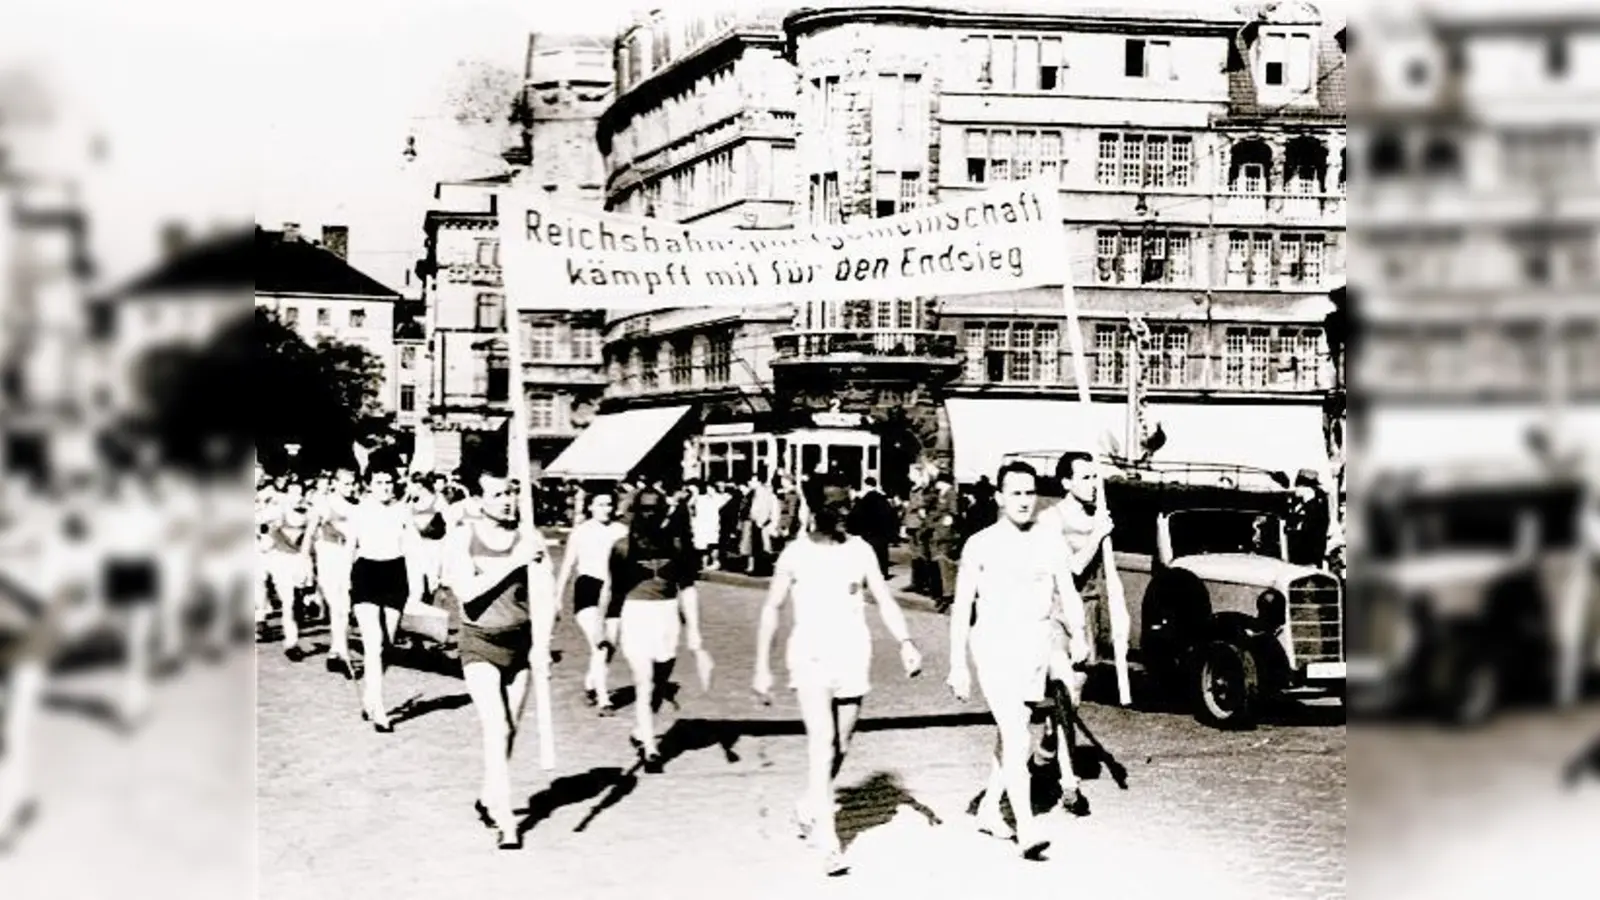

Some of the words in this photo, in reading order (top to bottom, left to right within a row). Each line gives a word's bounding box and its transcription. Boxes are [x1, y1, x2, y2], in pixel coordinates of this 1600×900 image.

[525, 191, 1042, 253] Reichsbahngeinschaft
[566, 258, 691, 295] kämpft
[705, 262, 758, 286] mit
[771, 260, 822, 285] für
[834, 254, 889, 282] den
[901, 242, 1023, 278] Endsieg
